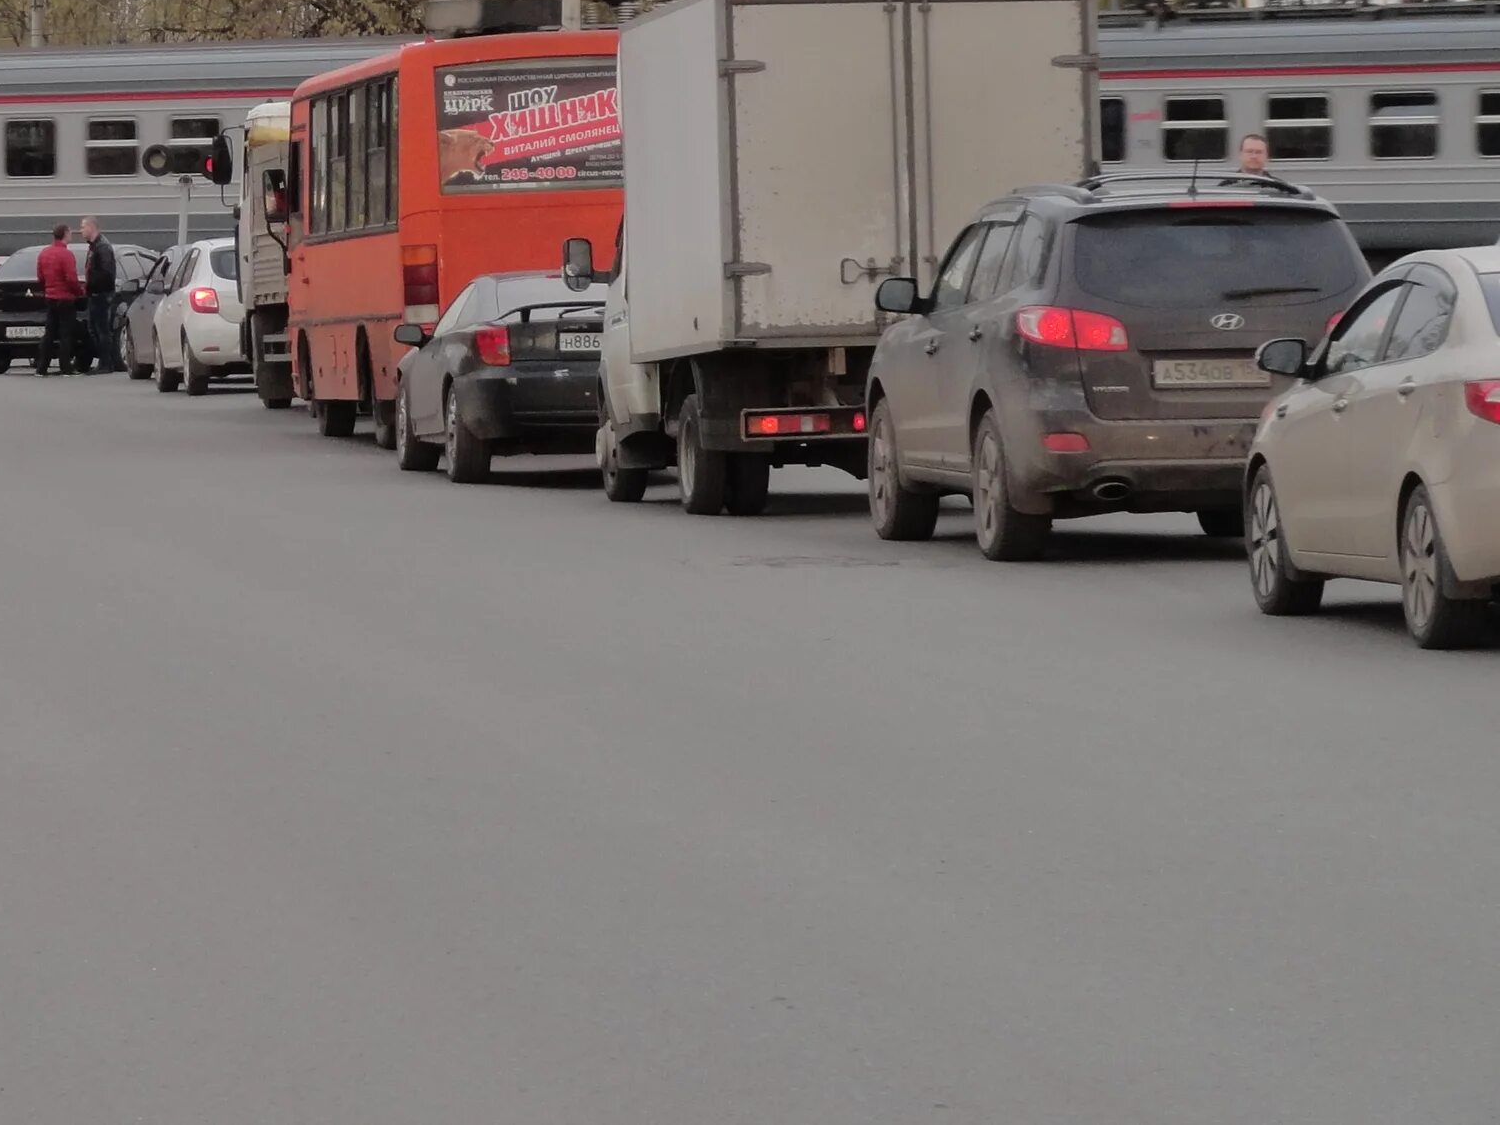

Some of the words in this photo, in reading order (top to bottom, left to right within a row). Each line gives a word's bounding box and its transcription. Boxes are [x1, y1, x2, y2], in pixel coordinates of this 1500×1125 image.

[508, 85, 557, 113] ШОУ
[503, 137, 556, 156] ВИТАЛИЙ
[558, 124, 620, 144] СМОЛЯНЕЦ
